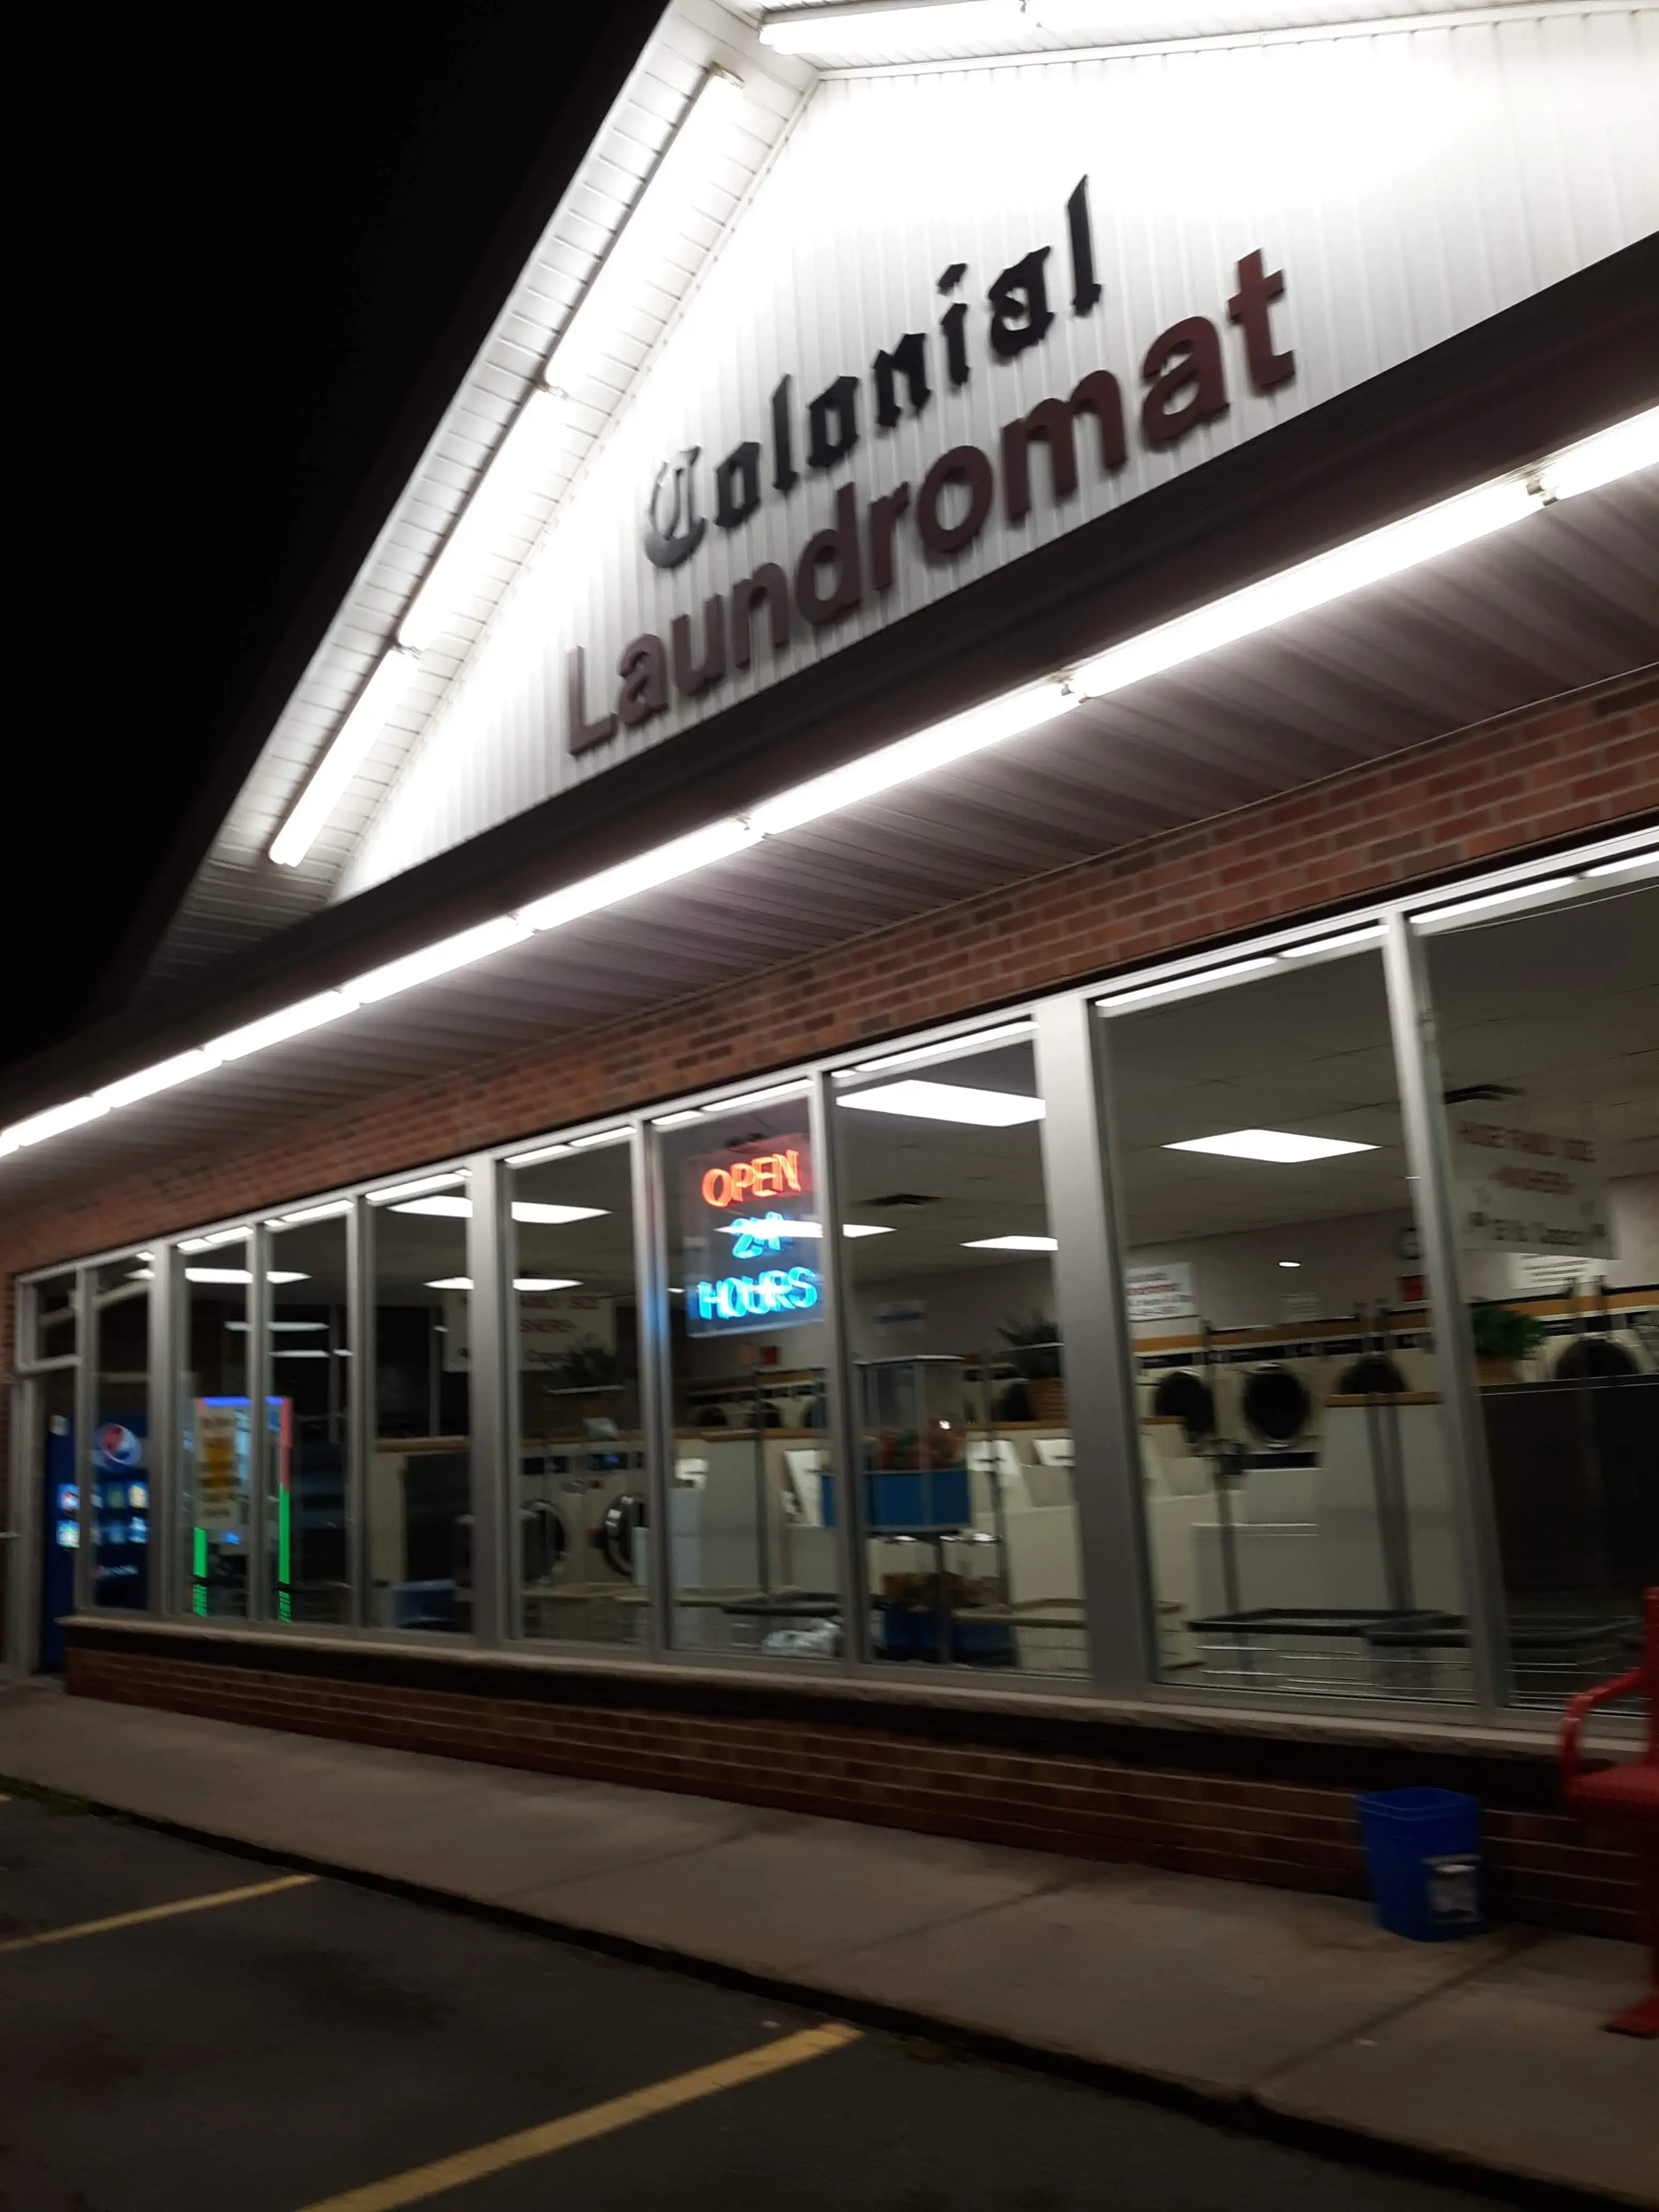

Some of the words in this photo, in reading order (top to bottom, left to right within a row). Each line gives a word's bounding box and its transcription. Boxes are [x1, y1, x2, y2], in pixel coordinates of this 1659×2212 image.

[644, 176, 1102, 569] Colonial
[567, 248, 1297, 757] Laundromat
[702, 1150, 800, 1207] OPEN
[698, 1267, 817, 1319] HOURS
